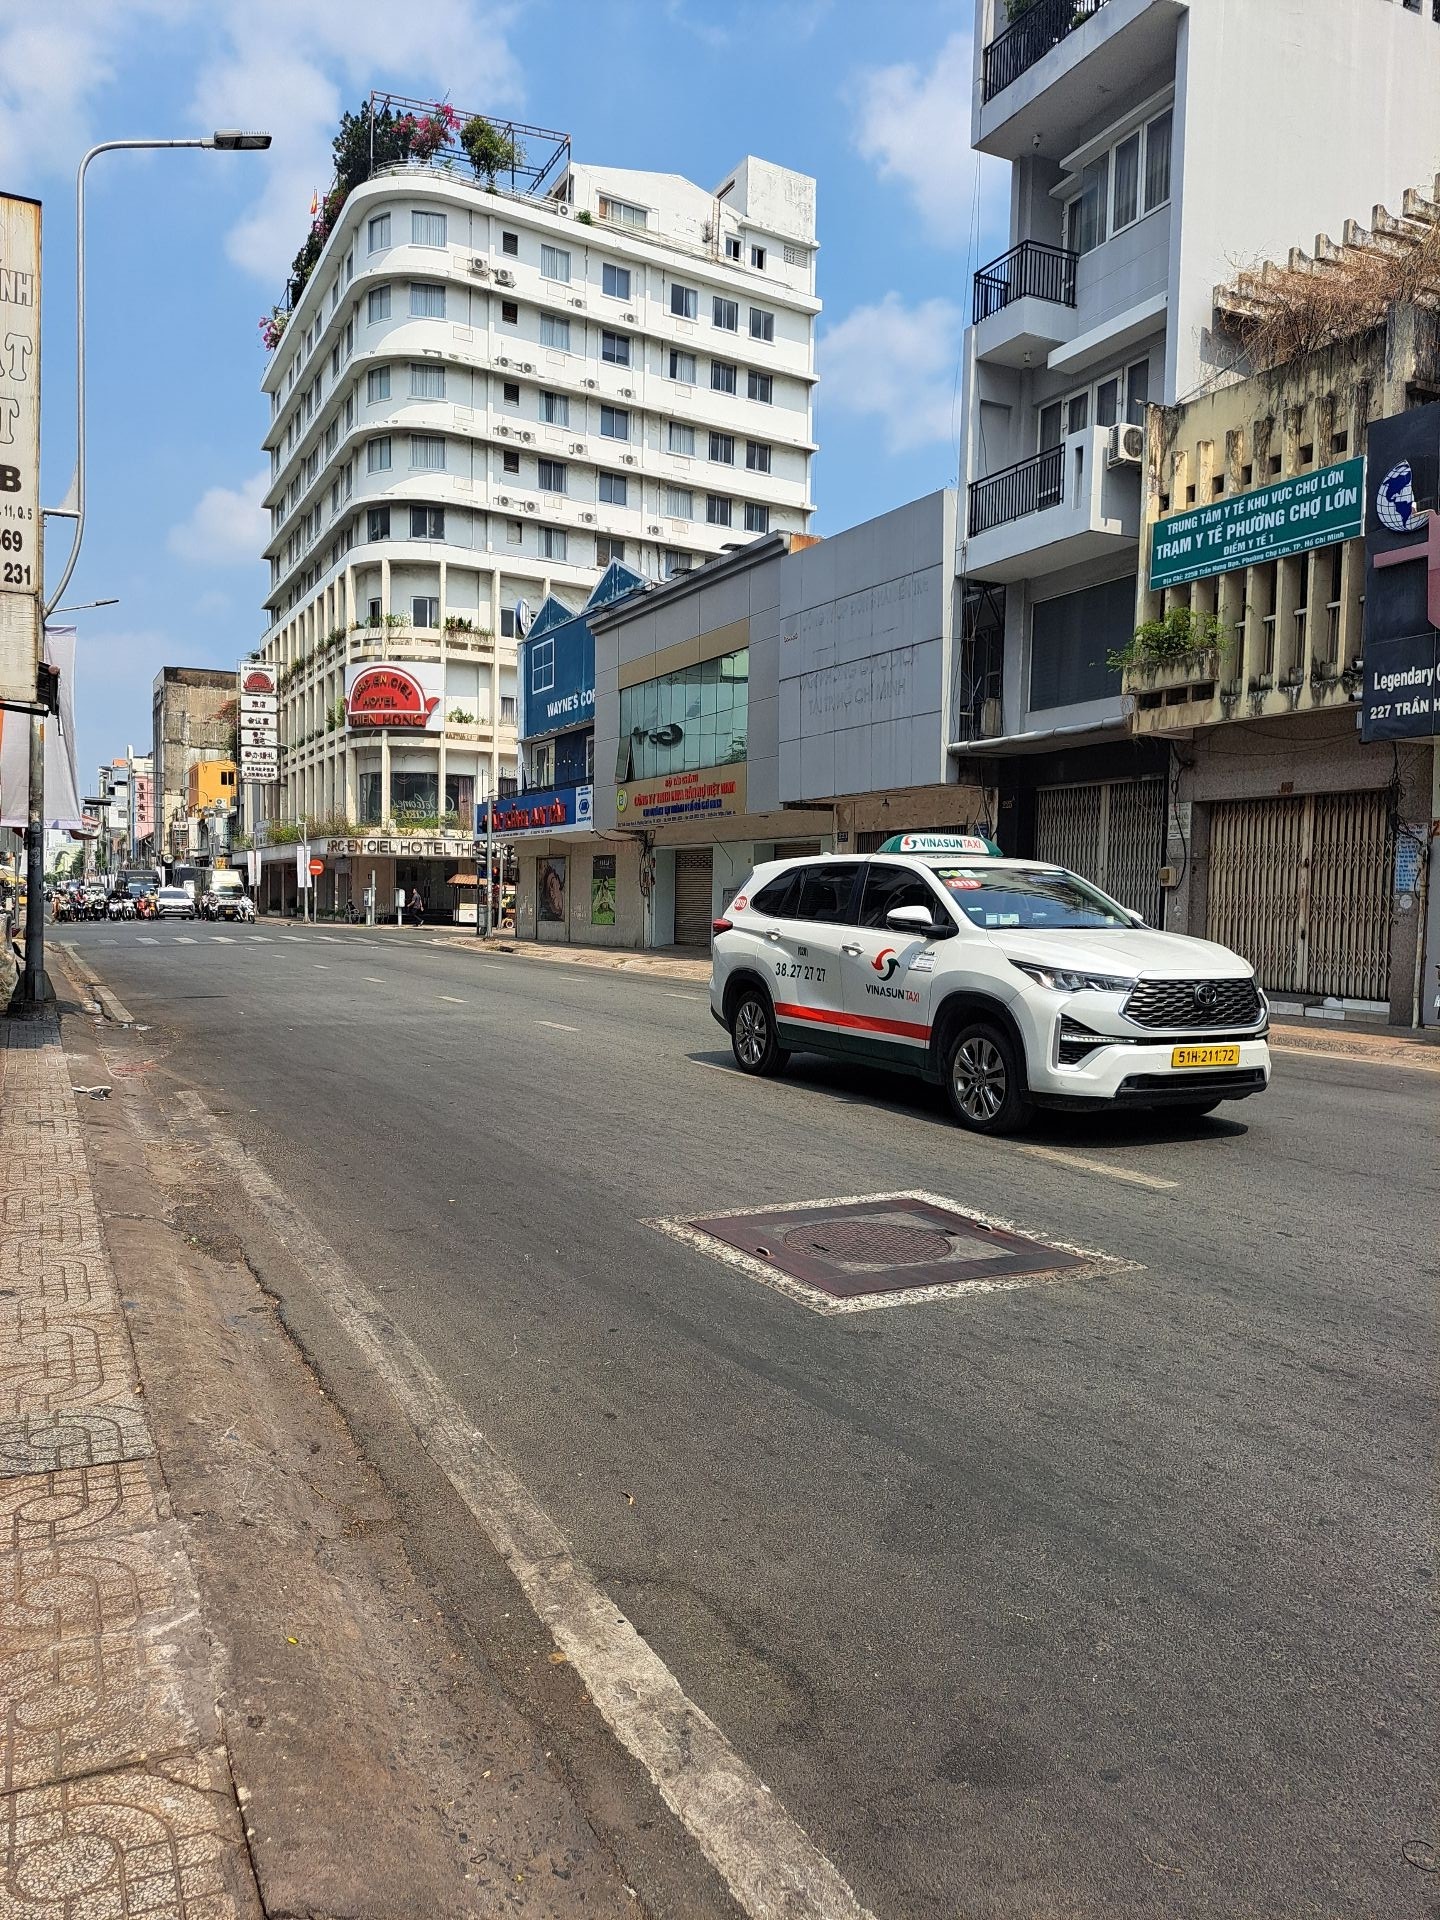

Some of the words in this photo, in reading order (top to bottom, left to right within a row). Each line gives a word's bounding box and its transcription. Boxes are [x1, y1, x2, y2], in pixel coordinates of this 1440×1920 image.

[0, 332, 32, 381] T
[1167, 516, 1198, 536] TRUNG
[1200, 509, 1221, 526] TÂM
[1224, 505, 1231, 519] Y
[1233, 497, 1246, 516] TẾ
[1247, 494, 1269, 512] KHU
[1271, 487, 1292, 505] VỰC
[1295, 476, 1318, 495] CHỢ
[1321, 469, 1344, 489] LỚN
[1156, 536, 1192, 560] TRẠM
[1195, 532, 1204, 549] Y
[1207, 522, 1225, 546] TẾ
[1226, 509, 1286, 540] PHƯỜNG
[1289, 495, 1321, 522] CHỢ
[1325, 487, 1357, 512] LỚN
[0, 528, 22, 552] 69
[1223, 539, 1246, 556] ĐIỂM
[1248, 539, 1255, 550] Y
[1256, 532, 1268, 546] TẾ
[1269, 534, 1274, 543] 1
[3, 562, 31, 585] 231
[1374, 666, 1434, 692] Legendary
[363, 696, 397, 708] HOTEL
[547, 693, 579, 717] WAYNE'S
[1370, 705, 1391, 720] 227
[1395, 695, 1429, 716] TRẦN
[401, 841, 451, 855] HOTEL
[804, 966, 814, 981] 27
[816, 967, 826, 982] 27
